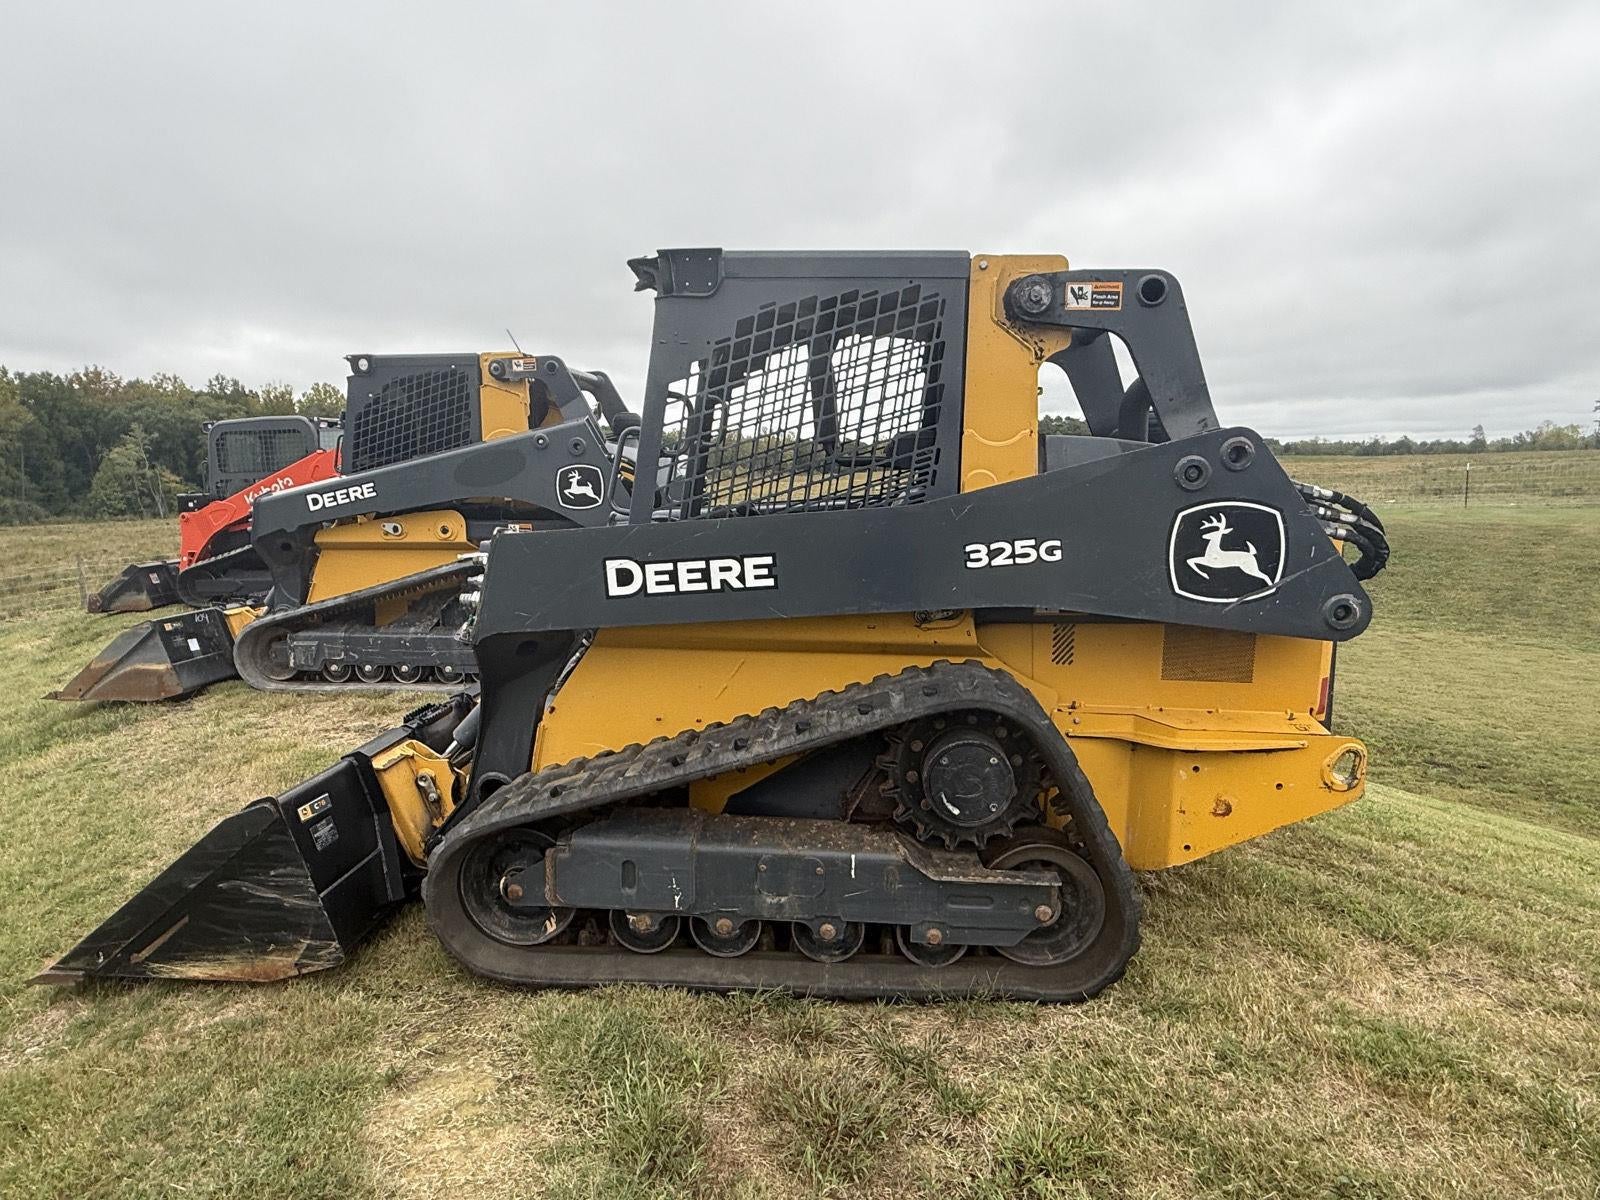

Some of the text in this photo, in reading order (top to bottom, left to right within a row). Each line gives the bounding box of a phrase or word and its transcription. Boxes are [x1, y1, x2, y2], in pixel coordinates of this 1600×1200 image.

[306, 482, 377, 511] DEERE
[965, 539, 1063, 569] 325G
[605, 555, 776, 597] DEERE
